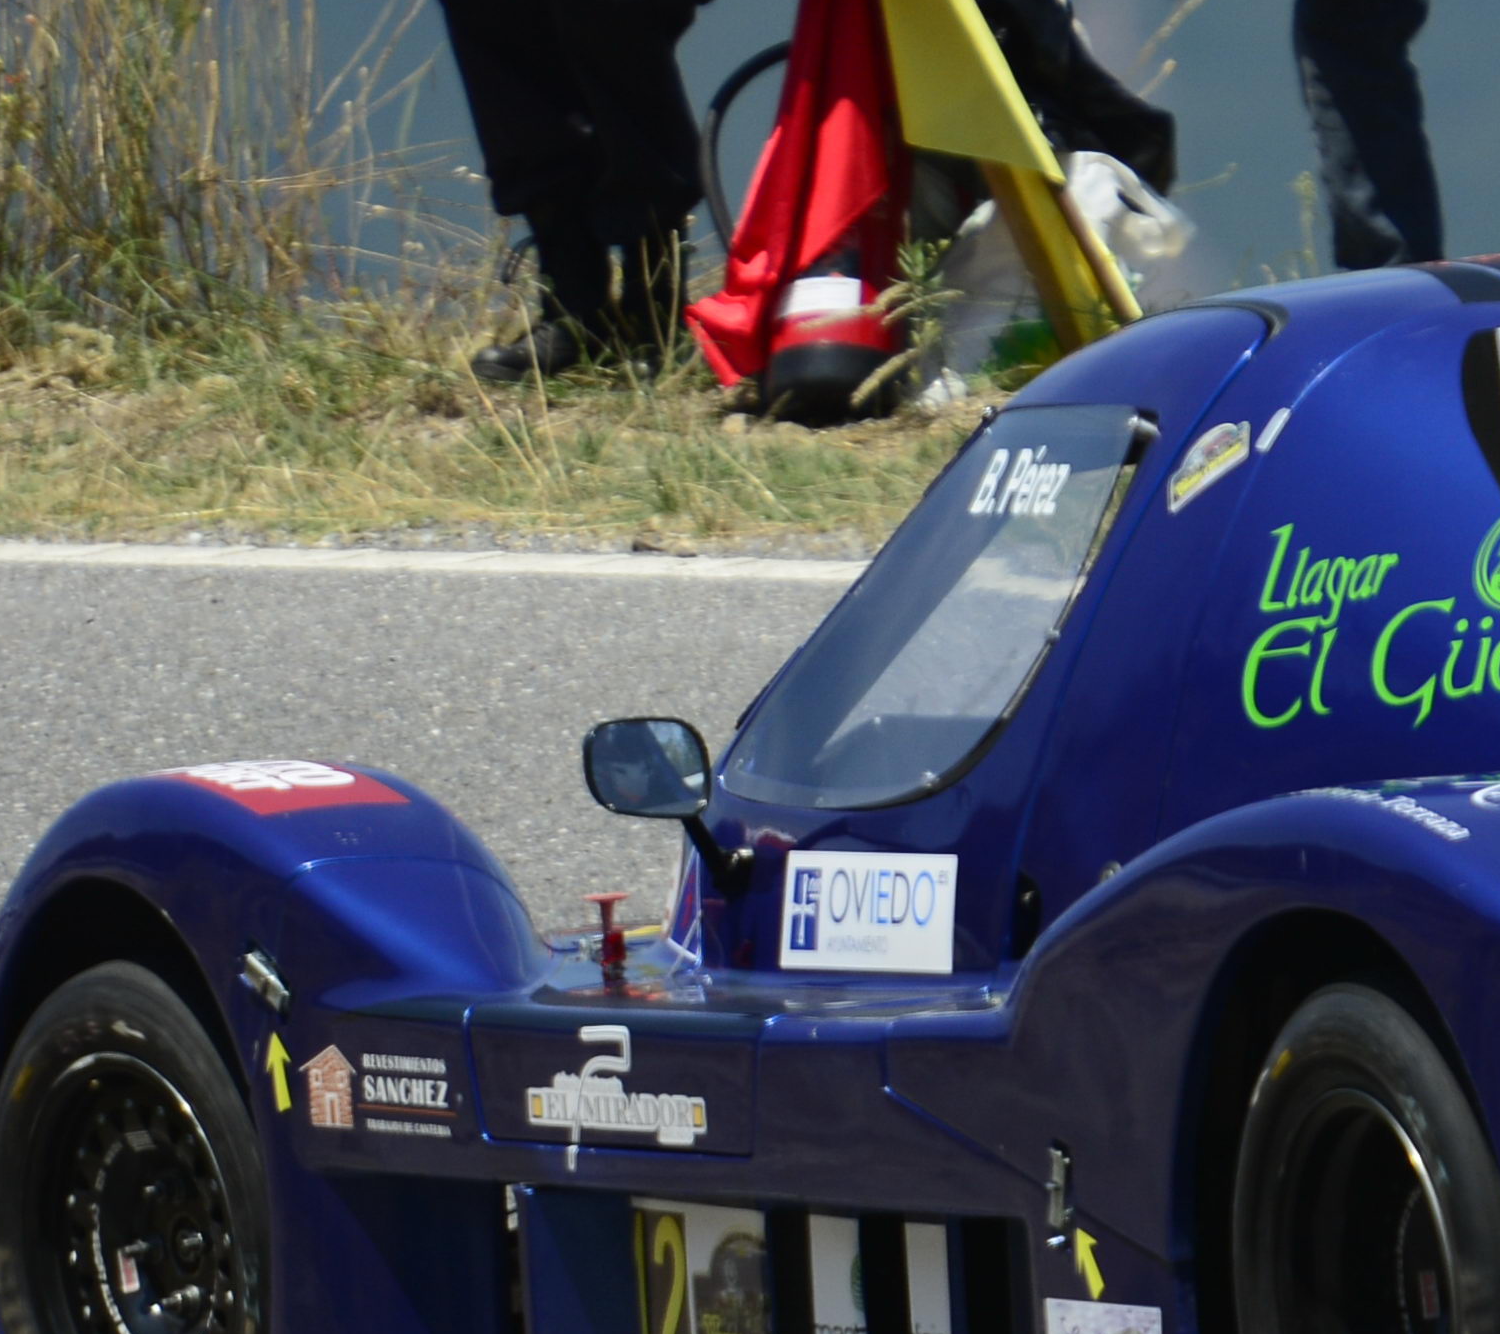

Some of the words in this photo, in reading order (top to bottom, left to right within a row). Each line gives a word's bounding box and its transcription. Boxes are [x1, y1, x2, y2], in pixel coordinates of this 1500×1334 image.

[1260, 523, 1399, 626] Llagar
[1241, 617, 1332, 729] El
[829, 869, 935, 926] OVIEDO
[363, 1053, 446, 1075] REVESTIMIENTOS
[364, 1075, 449, 1108] SANCHEZ
